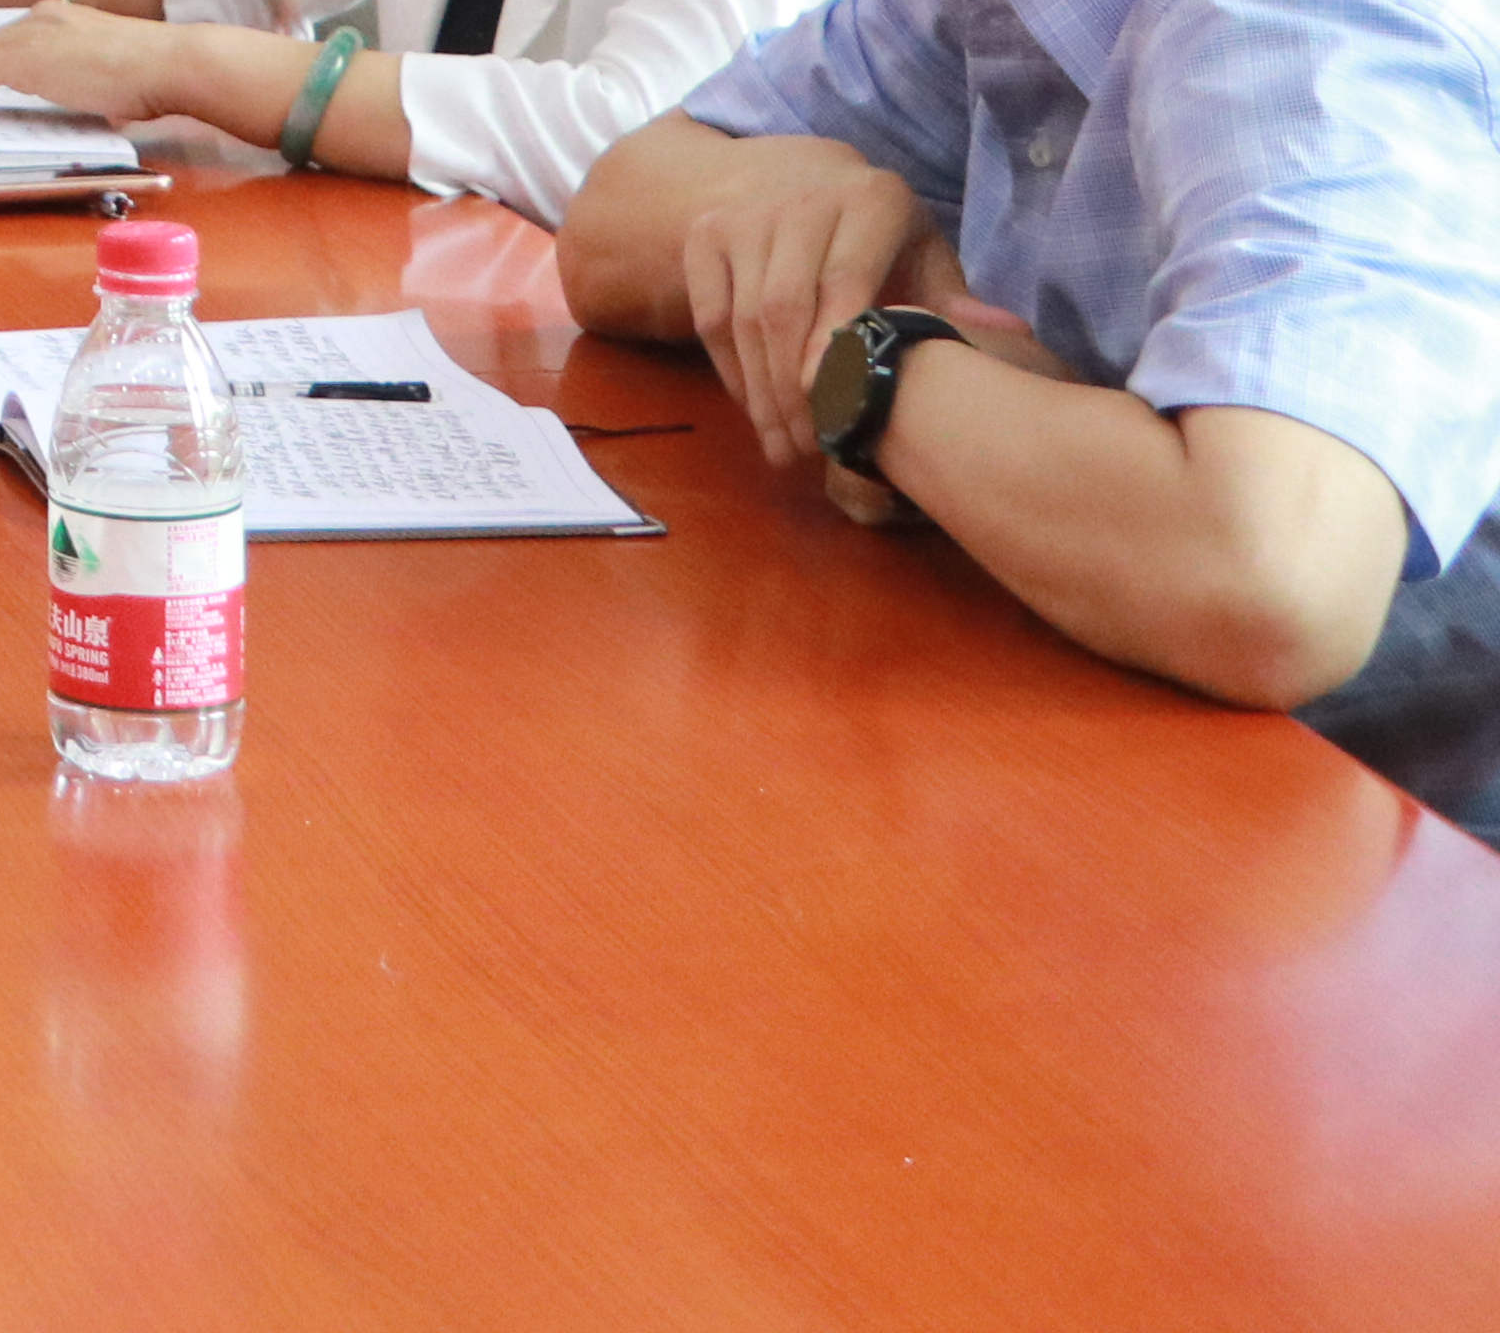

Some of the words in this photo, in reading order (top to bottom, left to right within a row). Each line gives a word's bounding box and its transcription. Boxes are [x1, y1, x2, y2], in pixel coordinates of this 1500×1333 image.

[49, 602, 110, 648] 夫山泉
[64, 642, 109, 667] SPRING
